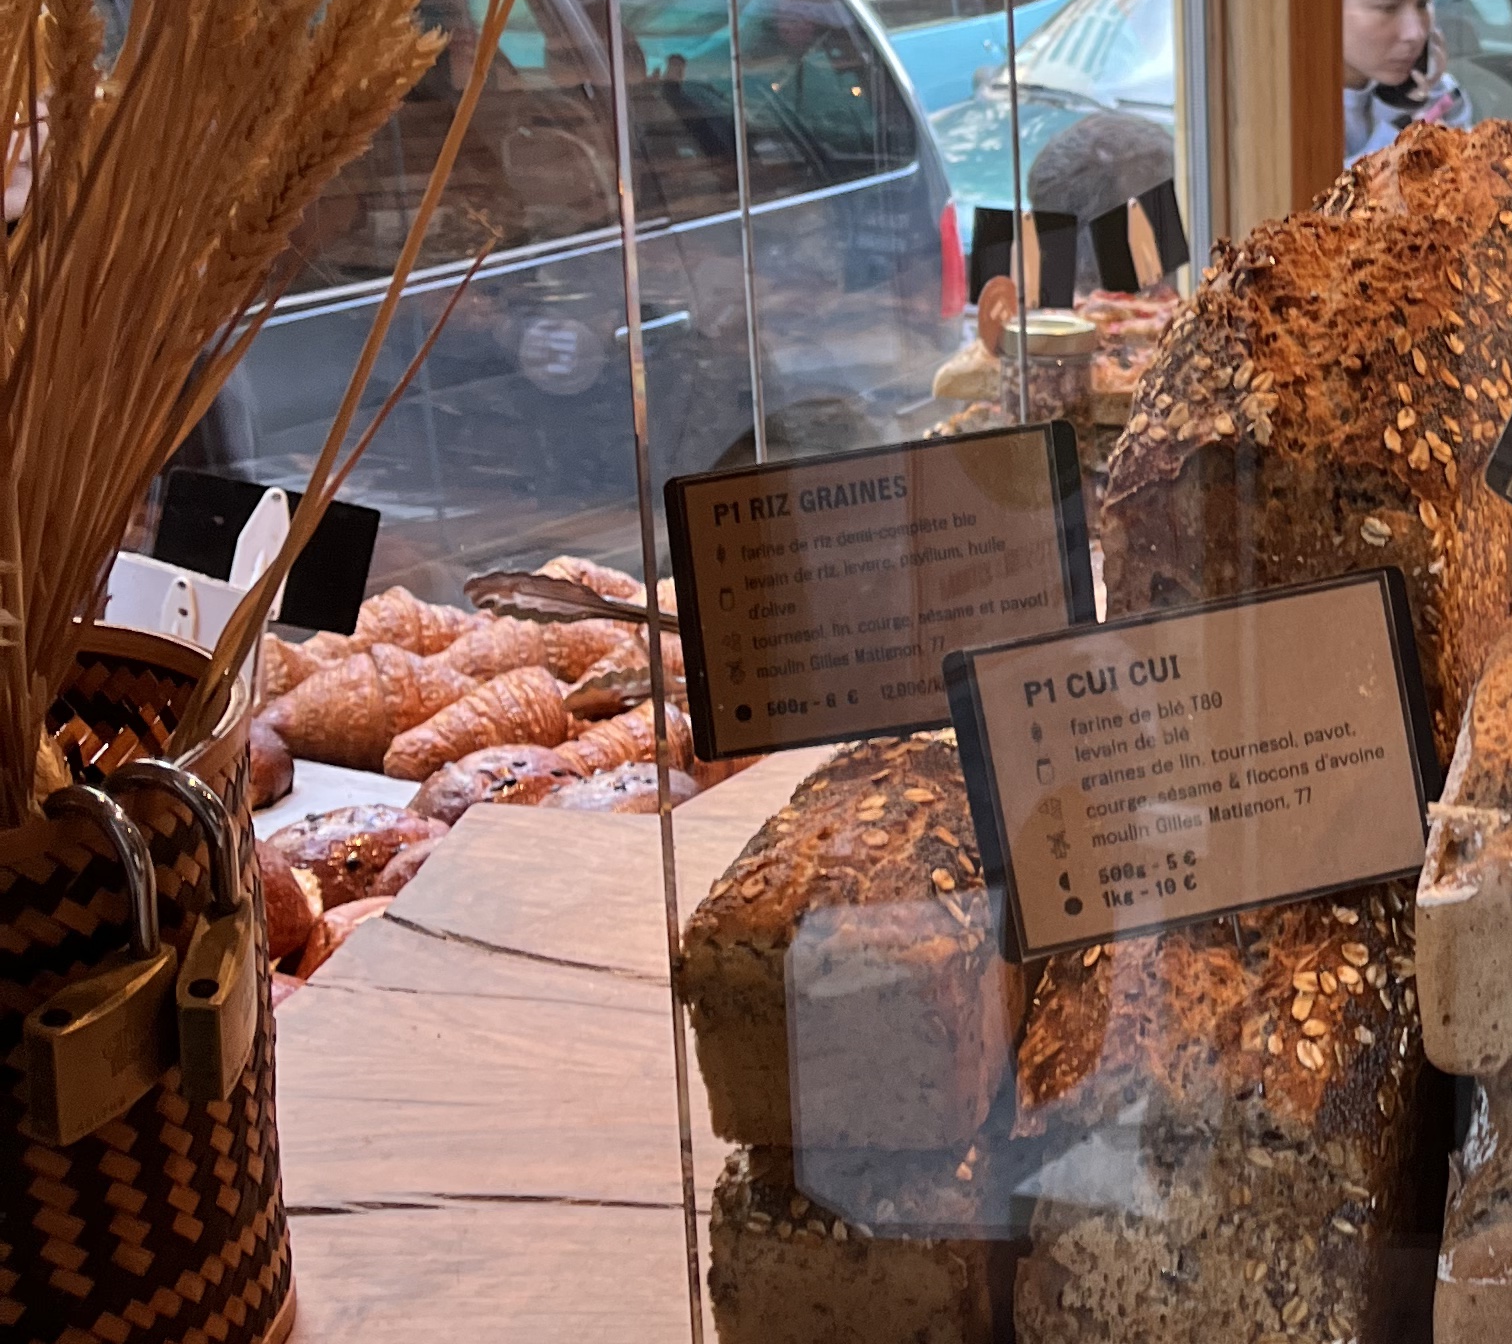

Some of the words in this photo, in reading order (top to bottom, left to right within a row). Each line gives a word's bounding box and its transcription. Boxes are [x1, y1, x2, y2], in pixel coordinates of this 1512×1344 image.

[713, 500, 741, 526] P1
[748, 492, 791, 521] RIZ
[799, 474, 907, 513] GRAINES
[740, 541, 784, 563] farine
[787, 536, 808, 555] de
[812, 533, 831, 551] riz
[951, 510, 977, 529] bio
[744, 571, 789, 592] levain
[792, 566, 813, 585] de
[967, 535, 1006, 556] huile
[978, 599, 995, 616] et
[755, 657, 805, 680] moulin
[809, 651, 849, 672] Gilles
[929, 634, 946, 653] 77
[1023, 677, 1056, 707] P1
[1065, 665, 1118, 699] CUI
[1127, 653, 1180, 687] CUI
[766, 697, 808, 718] 500g
[846, 688, 859, 705] €
[1069, 711, 1123, 736] farine
[1127, 705, 1151, 725] de
[1156, 698, 1185, 720] blé
[1190, 689, 1223, 712] T80
[1074, 738, 1128, 763] levain
[1133, 731, 1155, 751] de
[1162, 725, 1190, 746] blé
[1079, 763, 1146, 792] graines
[1150, 757, 1174, 777] de
[1156, 777, 1223, 804] sésame
[1227, 771, 1240, 791] &
[1245, 759, 1309, 787] flocons
[1090, 820, 1149, 848] moulin
[1154, 811, 1202, 835] Gilles
[1293, 785, 1313, 807] 77
[1097, 860, 1146, 885] 500g
[1165, 852, 1178, 871] 5
[1182, 848, 1197, 868] €
[1101, 887, 1134, 908] 1kg
[1154, 876, 1177, 897] 10
[1182, 872, 1197, 892] €
